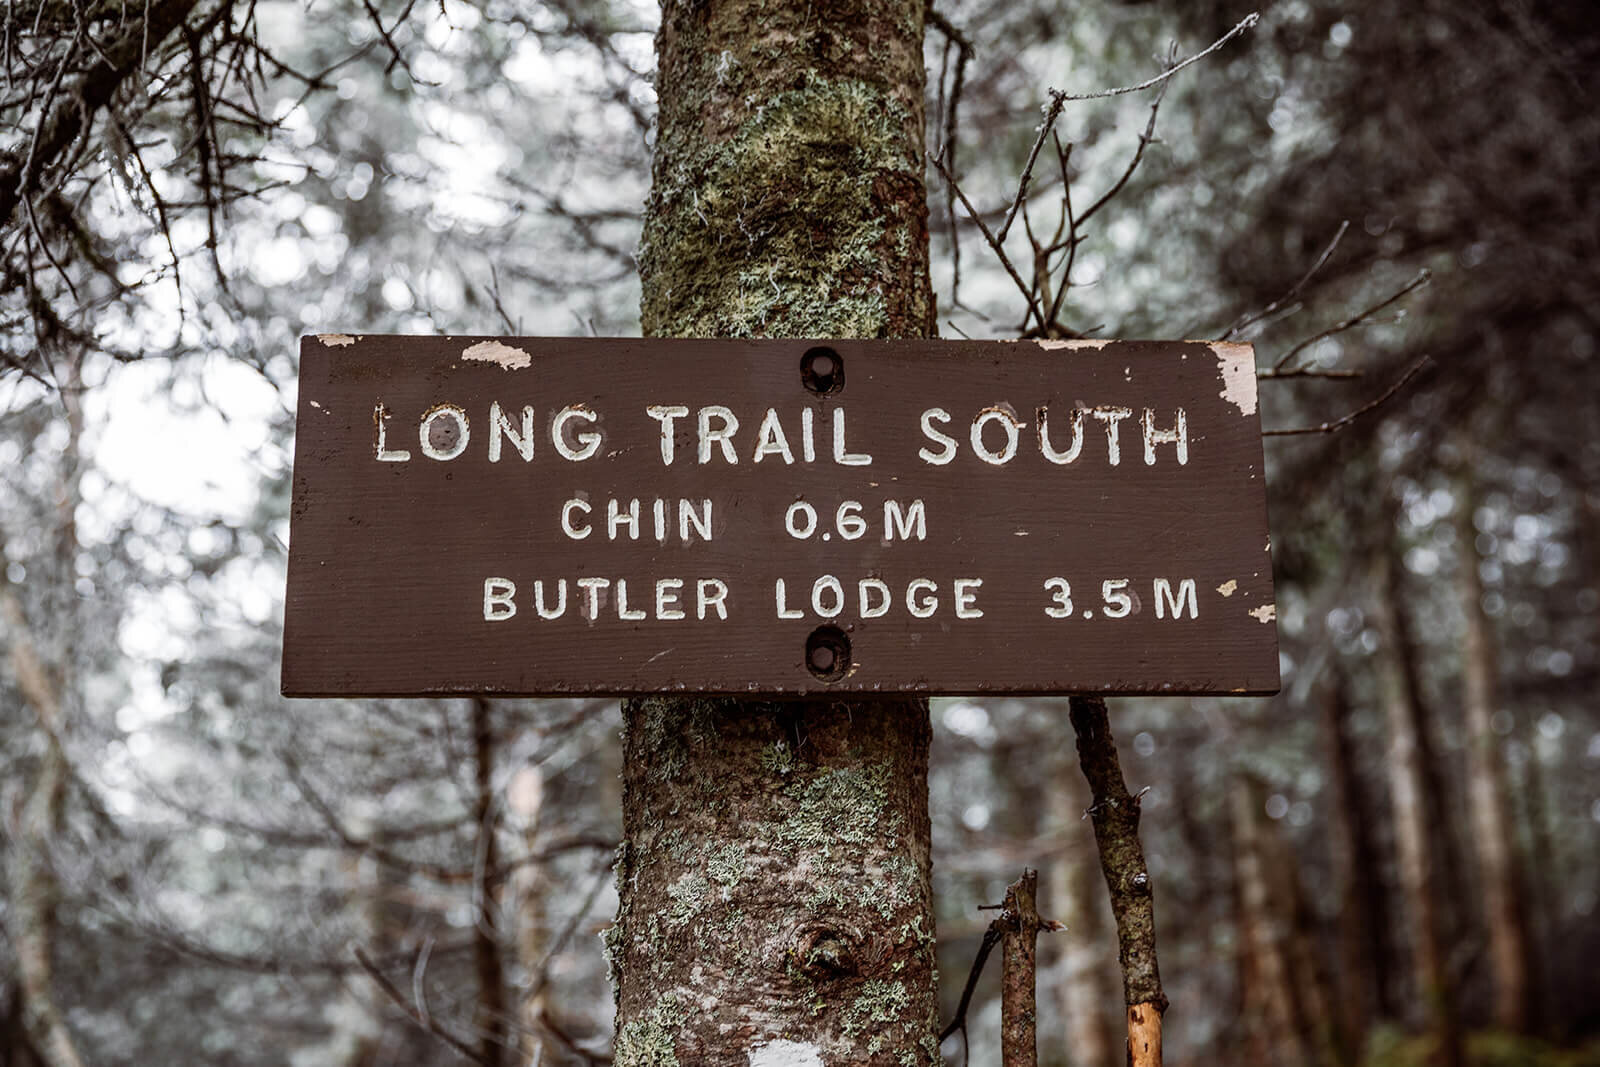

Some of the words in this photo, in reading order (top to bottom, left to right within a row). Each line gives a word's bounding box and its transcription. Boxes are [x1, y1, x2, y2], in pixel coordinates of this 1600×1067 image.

[375, 404, 602, 463] LONG
[646, 405, 873, 467] TRAIL
[918, 406, 1189, 467] SOUTH
[561, 497, 713, 542] CHIN
[483, 576, 729, 622] BUTLER
[775, 574, 984, 620] LODGE
